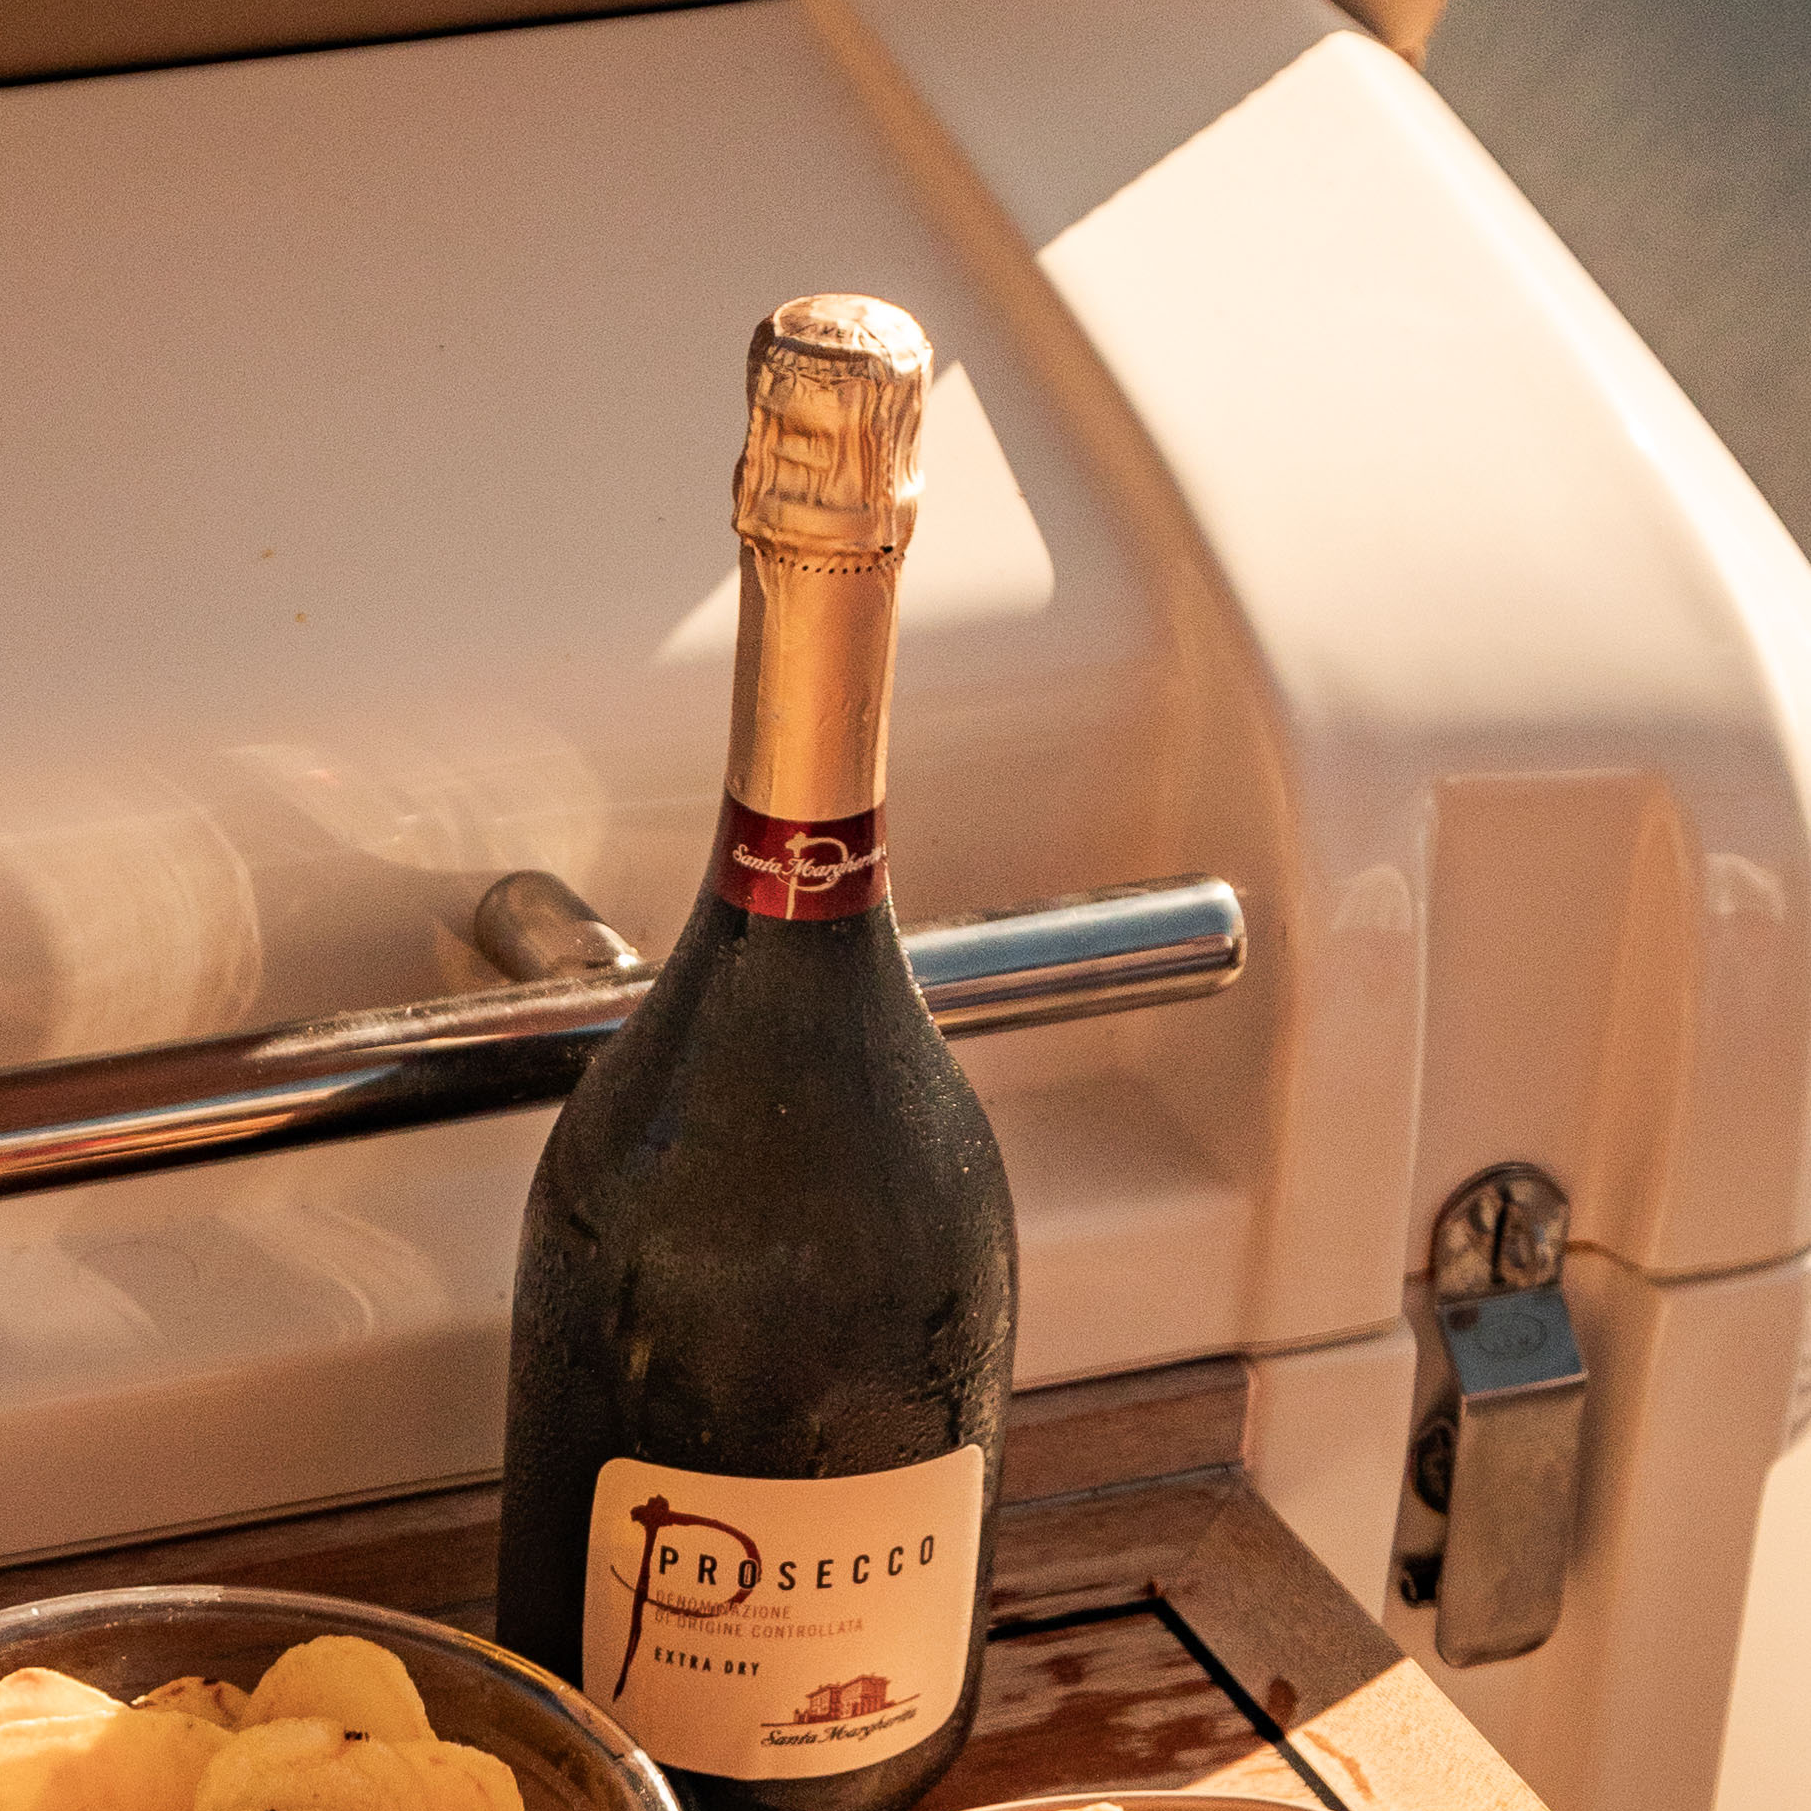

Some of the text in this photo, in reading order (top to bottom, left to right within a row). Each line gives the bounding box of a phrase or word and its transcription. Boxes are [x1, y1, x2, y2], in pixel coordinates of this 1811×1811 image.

[732, 843, 783, 874] Santa
[658, 1535, 936, 1592] PROSECCO
[655, 1590, 792, 1620] DENOMINAZIONE
[676, 1616, 742, 1638] ORIGINE
[751, 1617, 863, 1640] CONTROLLATA
[653, 1646, 760, 1677] EXTRA DRY
[760, 1729, 818, 1746] Santa
